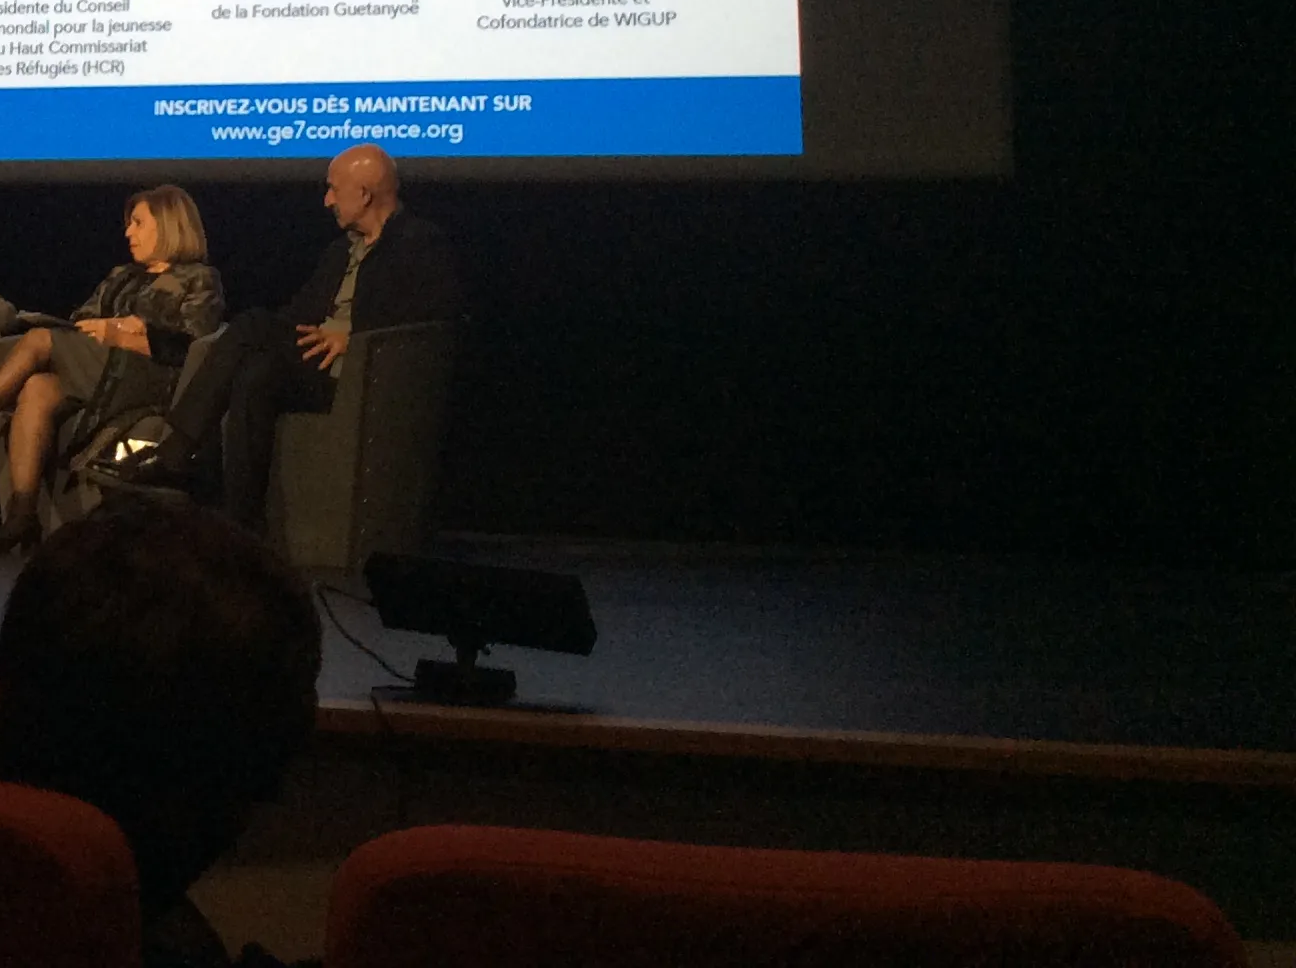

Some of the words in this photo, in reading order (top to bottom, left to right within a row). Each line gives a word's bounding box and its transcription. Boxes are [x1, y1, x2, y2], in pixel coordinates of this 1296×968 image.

[53, 0, 72, 14] du
[211, 5, 231, 20] de
[235, 4, 248, 19] la
[252, 3, 329, 18] Fondation
[334, 0, 420, 20] Guetanyoë
[53, 23, 88, 39] pour
[92, 18, 104, 33] la
[107, 19, 172, 37] jeunesse
[477, 13, 584, 29] Cofondatrice
[588, 12, 609, 27] de
[614, 11, 677, 26] WIGUP
[9, 41, 44, 55] Haut
[48, 39, 147, 54] Commissariat
[16, 60, 78, 79] Réfugiés
[82, 60, 125, 76] (HCR)
[154, 98, 308, 115] INSCRIVEZ-VOUS
[313, 95, 350, 113] DÈS
[355, 95, 488, 112] MAINTENANT
[493, 95, 532, 111] SUR
[212, 119, 463, 145] www.ge7conference.org
